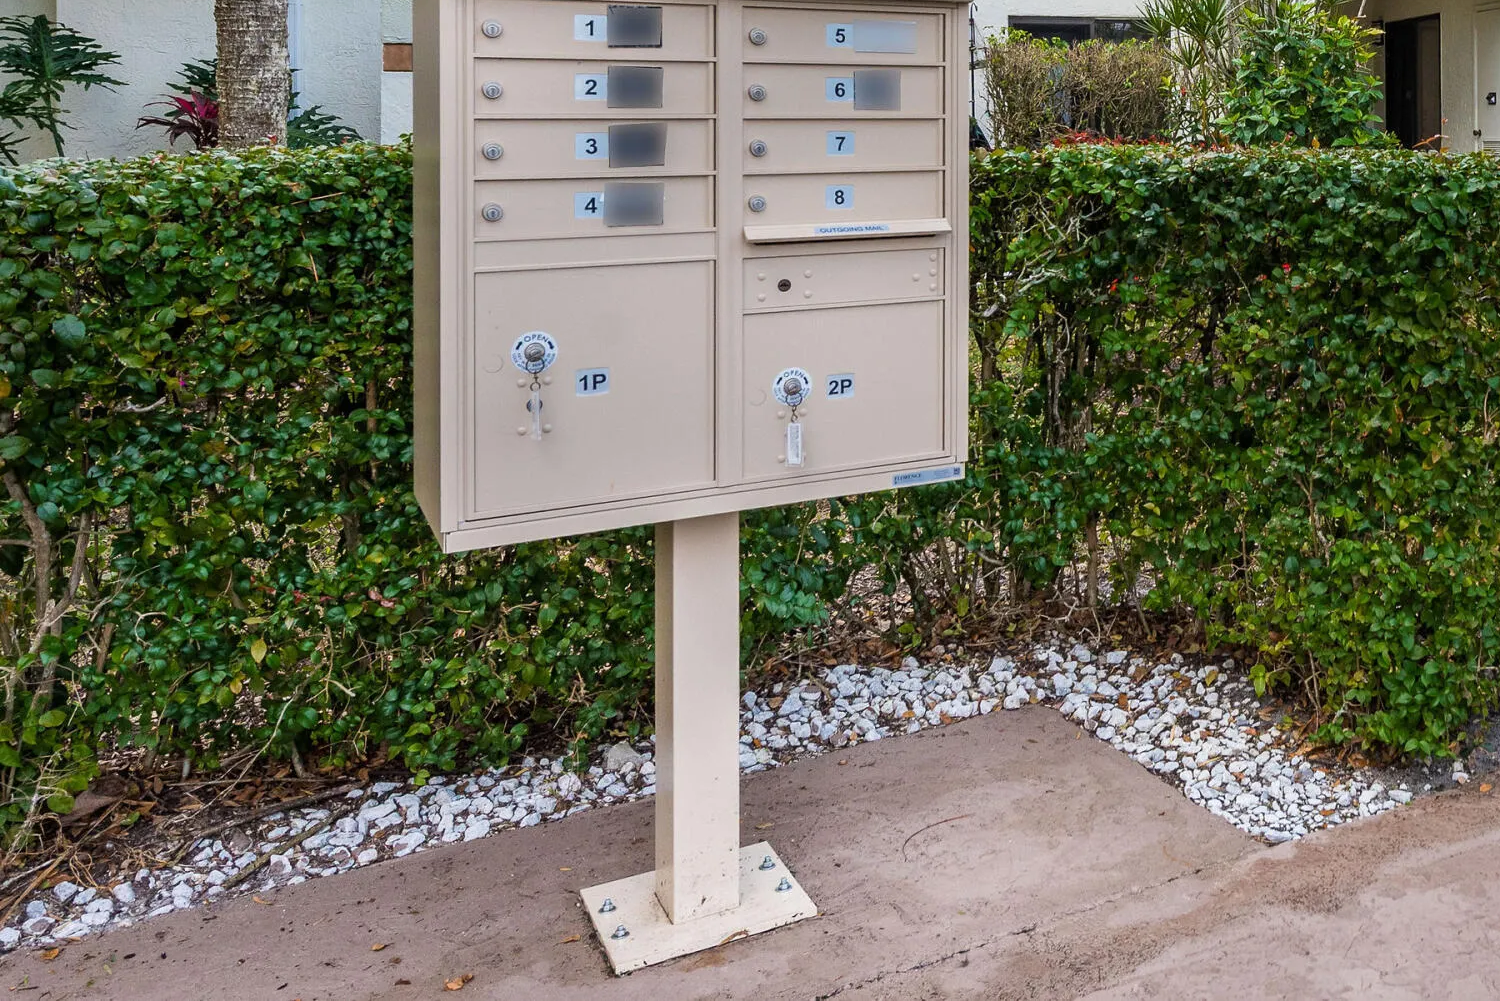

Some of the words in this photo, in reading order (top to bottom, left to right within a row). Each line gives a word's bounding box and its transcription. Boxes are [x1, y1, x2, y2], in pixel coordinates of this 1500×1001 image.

[585, 19, 594, 37] 1
[835, 28, 846, 44] 5
[584, 79, 598, 96] 2
[834, 82, 846, 98] 6
[585, 138, 598, 155] 3
[835, 136, 846, 152] 7
[834, 189, 845, 205] 8
[584, 197, 598, 214] 4
[819, 225, 864, 234] OUTGOING
[523, 333, 549, 343] OPEN
[783, 369, 805, 378] OPEN
[579, 373, 607, 391] 1P
[828, 378, 853, 396] 2P
